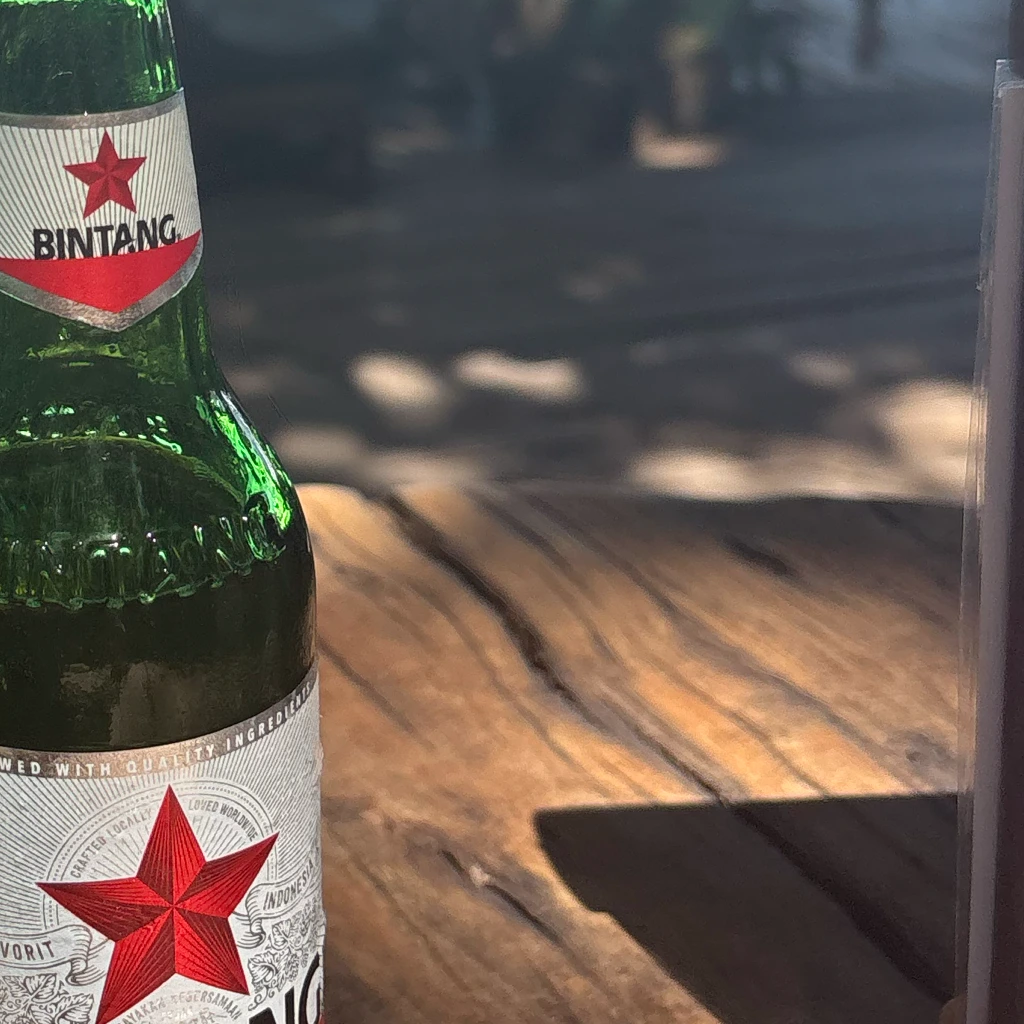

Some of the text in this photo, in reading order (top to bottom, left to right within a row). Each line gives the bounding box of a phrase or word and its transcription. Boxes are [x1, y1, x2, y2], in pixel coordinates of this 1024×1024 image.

[32, 214, 177, 260] BINTANG
[55, 762, 111, 777] WITH
[126, 744, 215, 774] QUALITY
[226, 681, 313, 751] INGREDIENTS
[70, 808, 152, 878] CRAFTED LOCALLY
[188, 799, 259, 842] LOVED WORLDWIDE
[262, 859, 314, 911] INDONESIA
